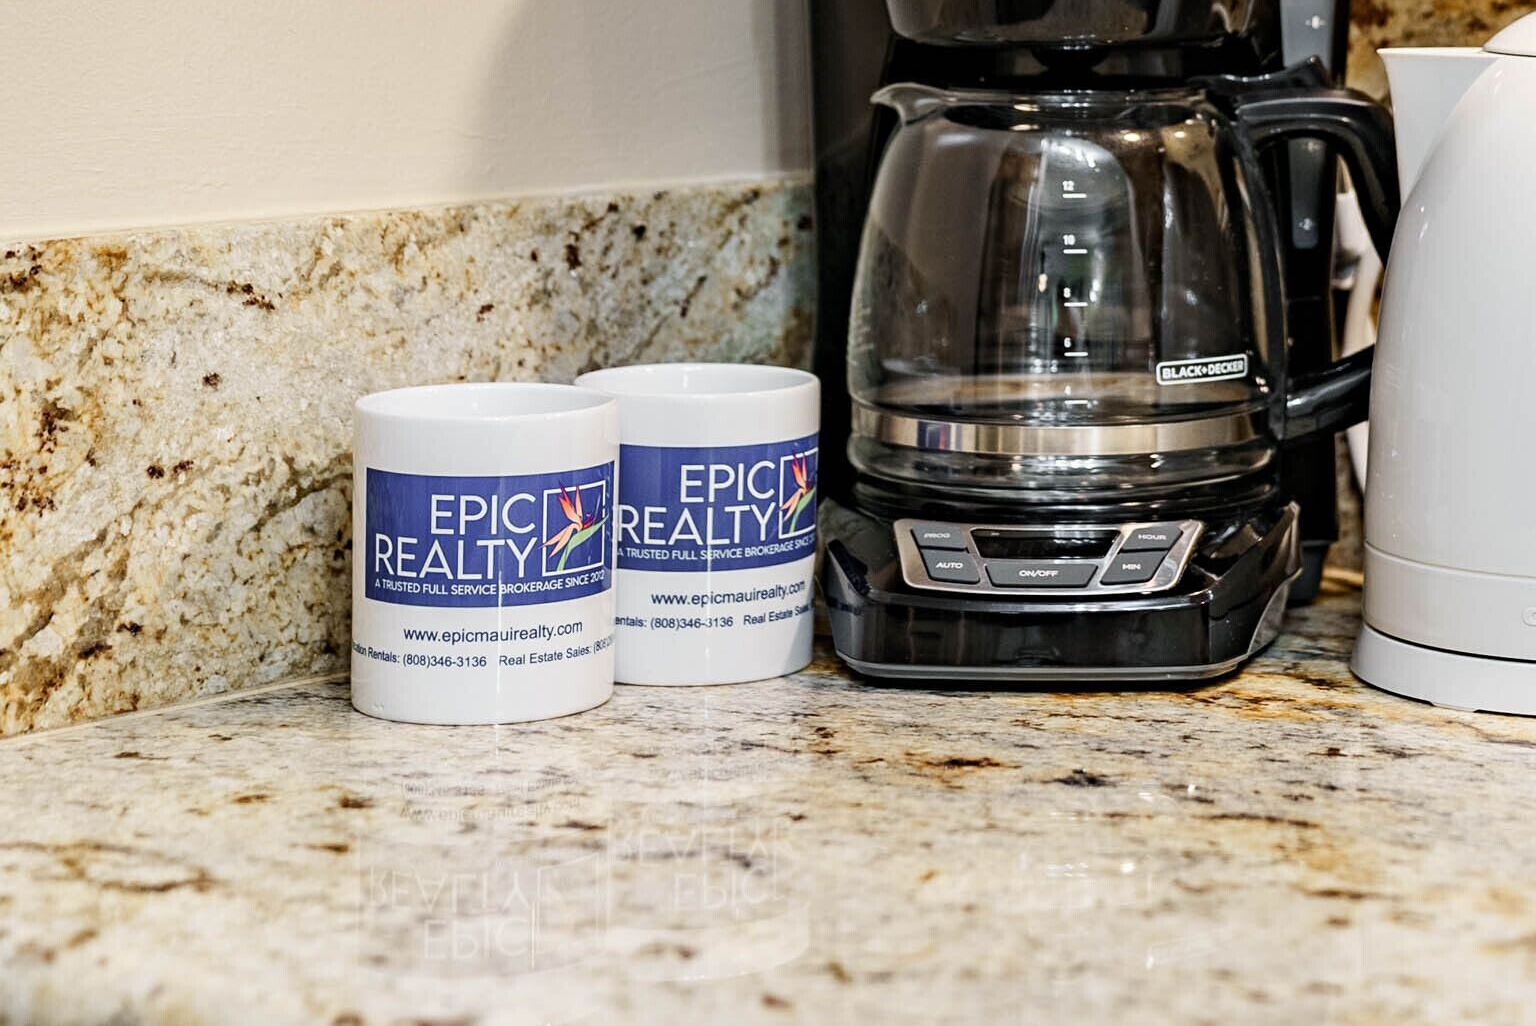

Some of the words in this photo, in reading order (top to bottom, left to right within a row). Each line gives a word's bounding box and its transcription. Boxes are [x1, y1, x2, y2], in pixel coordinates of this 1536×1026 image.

[1062, 180, 1075, 191] 12
[1062, 234, 1076, 246] 10
[1063, 287, 1072, 298] 8
[1063, 337, 1072, 348] 6
[1161, 359, 1245, 380] BLACK+DECKER
[680, 460, 776, 504] EPIC
[430, 492, 536, 535] EPIC
[616, 501, 777, 546] REALTY
[374, 532, 538, 580] REALTY
[625, 547, 670, 560] TRUSTED
[671, 549, 699, 560] FULL
[700, 548, 743, 561] SERVICE
[744, 540, 794, 557] BROKERAGE
[1018, 569, 1059, 577] ON/OFF
[374, 578, 381, 588] A
[381, 578, 421, 594] TRUSTED
[422, 582, 449, 595] FULL
[450, 584, 497, 595] SERVICE
[499, 579, 563, 594] BROKERAGE
[564, 576, 589, 588] SINCE
[651, 580, 806, 608] www.epicmauirealty.com
[614, 616, 648, 628] entals:
[650, 616, 734, 630] (808)346-3136
[743, 614, 766, 625] Real
[768, 609, 793, 623] Estate
[403, 620, 583, 645] www.epicmauirealty.com
[367, 645, 400, 663] Rentals:
[402, 653, 487, 668] (808)346-3136
[498, 654, 526, 666] Real
[529, 652, 563, 664] Estate
[566, 645, 592, 658] Sales:
